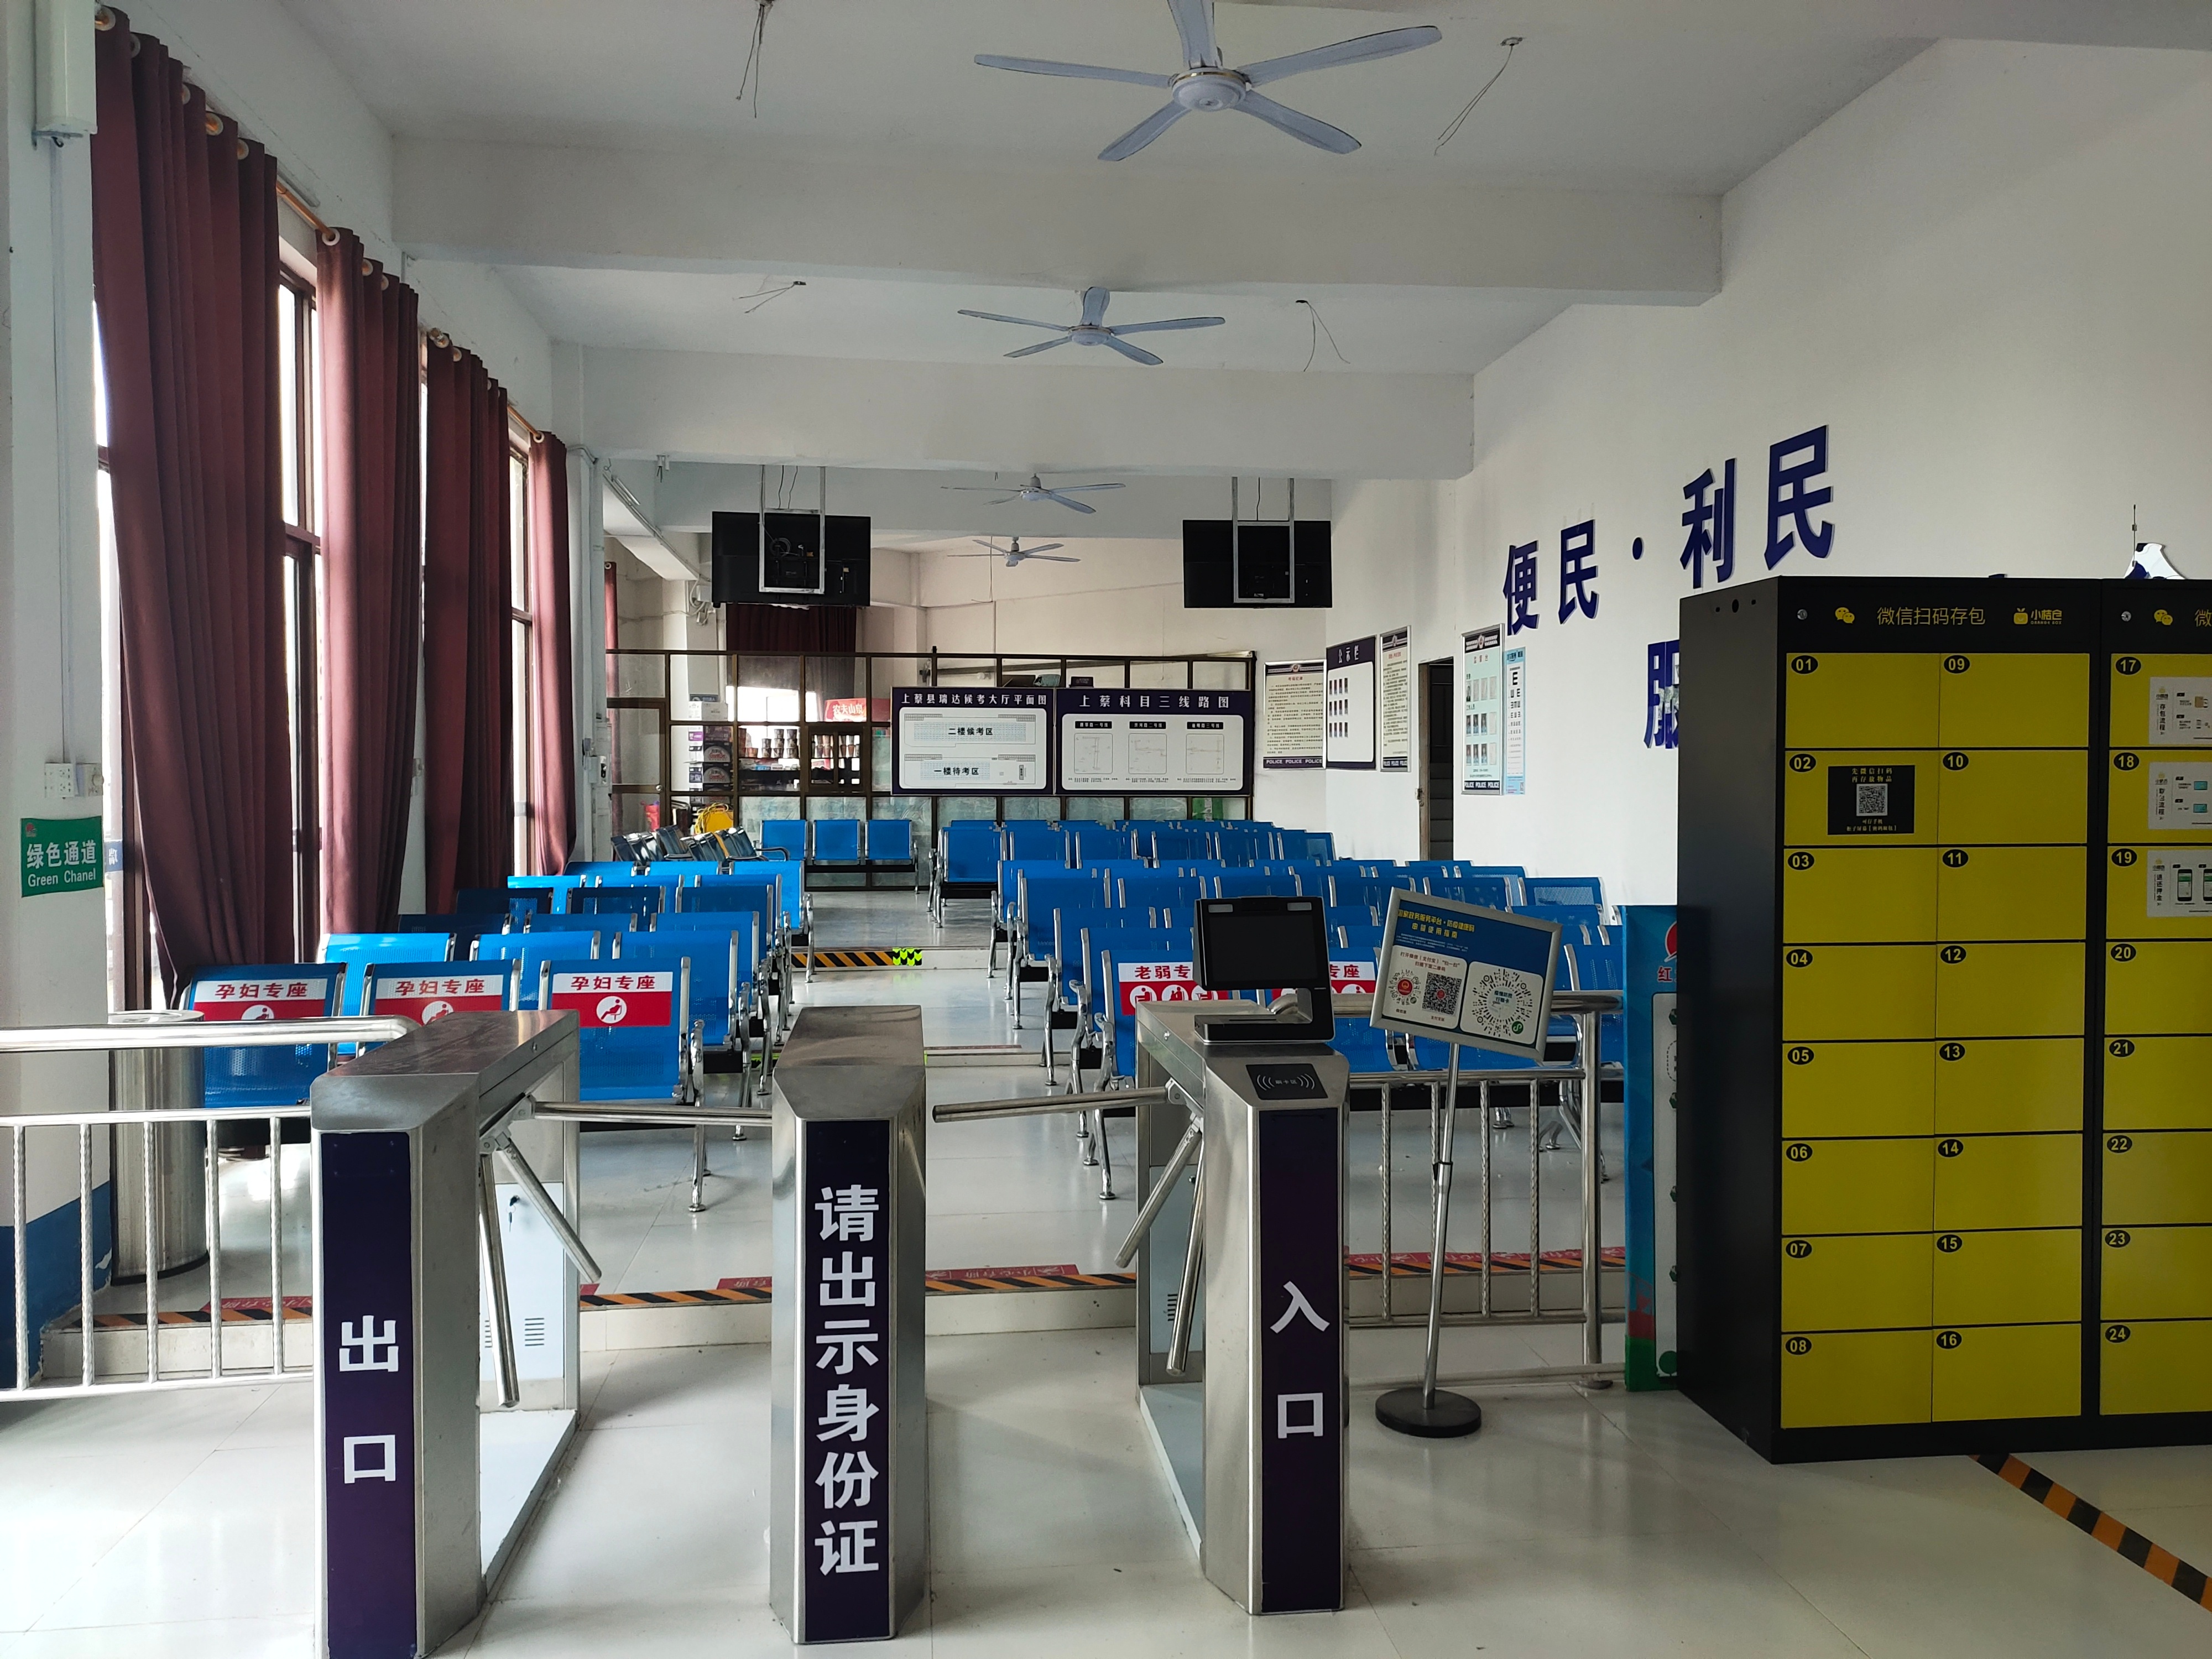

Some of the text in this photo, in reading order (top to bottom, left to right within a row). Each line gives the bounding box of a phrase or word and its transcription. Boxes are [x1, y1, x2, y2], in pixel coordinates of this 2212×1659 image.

[1877, 607, 1985, 627] 微信扫码存包
[2031, 609, 2062, 620] 小桔仓
[1796, 658, 1811, 671] 01
[1948, 658, 1965, 671] 09
[2120, 659, 2136, 672] 17
[901, 693, 1046, 705] 上蔡县瑞达候考大厅平面图
[1079, 695, 1229, 708] 上蔡科目三线路图
[833, 703, 863, 714] 农夫山泉
[948, 727, 993, 735] 二楼候考区
[1794, 757, 1811, 770] 02
[1948, 755, 1964, 768] 10
[2119, 755, 2134, 768] 18
[934, 767, 979, 775] 一楼待考区
[27, 839, 97, 869] 绿色通道
[1948, 852, 1961, 865] 11
[2116, 851, 2132, 864] 19
[1792, 854, 1809, 868] 03
[28, 868, 96, 887] Green Chanel
[1791, 952, 1808, 965] 04
[1945, 948, 1961, 961] 12
[2115, 947, 2131, 959] 20
[1135, 965, 1190, 979] 老弱专
[395, 979, 485, 996] 孕妇专座
[570, 975, 655, 991] 孕妇专座
[215, 982, 308, 999] 孕妇专座
[1944, 1045, 1960, 1058] 13
[2113, 1042, 2128, 1055] 21
[1792, 1050, 1809, 1062] 05
[1942, 1141, 1959, 1155] 14
[2111, 1138, 2127, 1151] 22
[1791, 1146, 1808, 1159] 06
[1942, 1237, 1958, 1250] 15
[2109, 1233, 2125, 1245] 23
[1790, 1243, 1807, 1255] 07
[2109, 1327, 2126, 1340] 24
[1790, 1340, 1807, 1352] 08
[1941, 1334, 1957, 1347] 16
[1270, 1280, 1330, 1438] 入口
[814, 1183, 880, 1577] 请出示身份证
[339, 1314, 399, 1484] 出口
